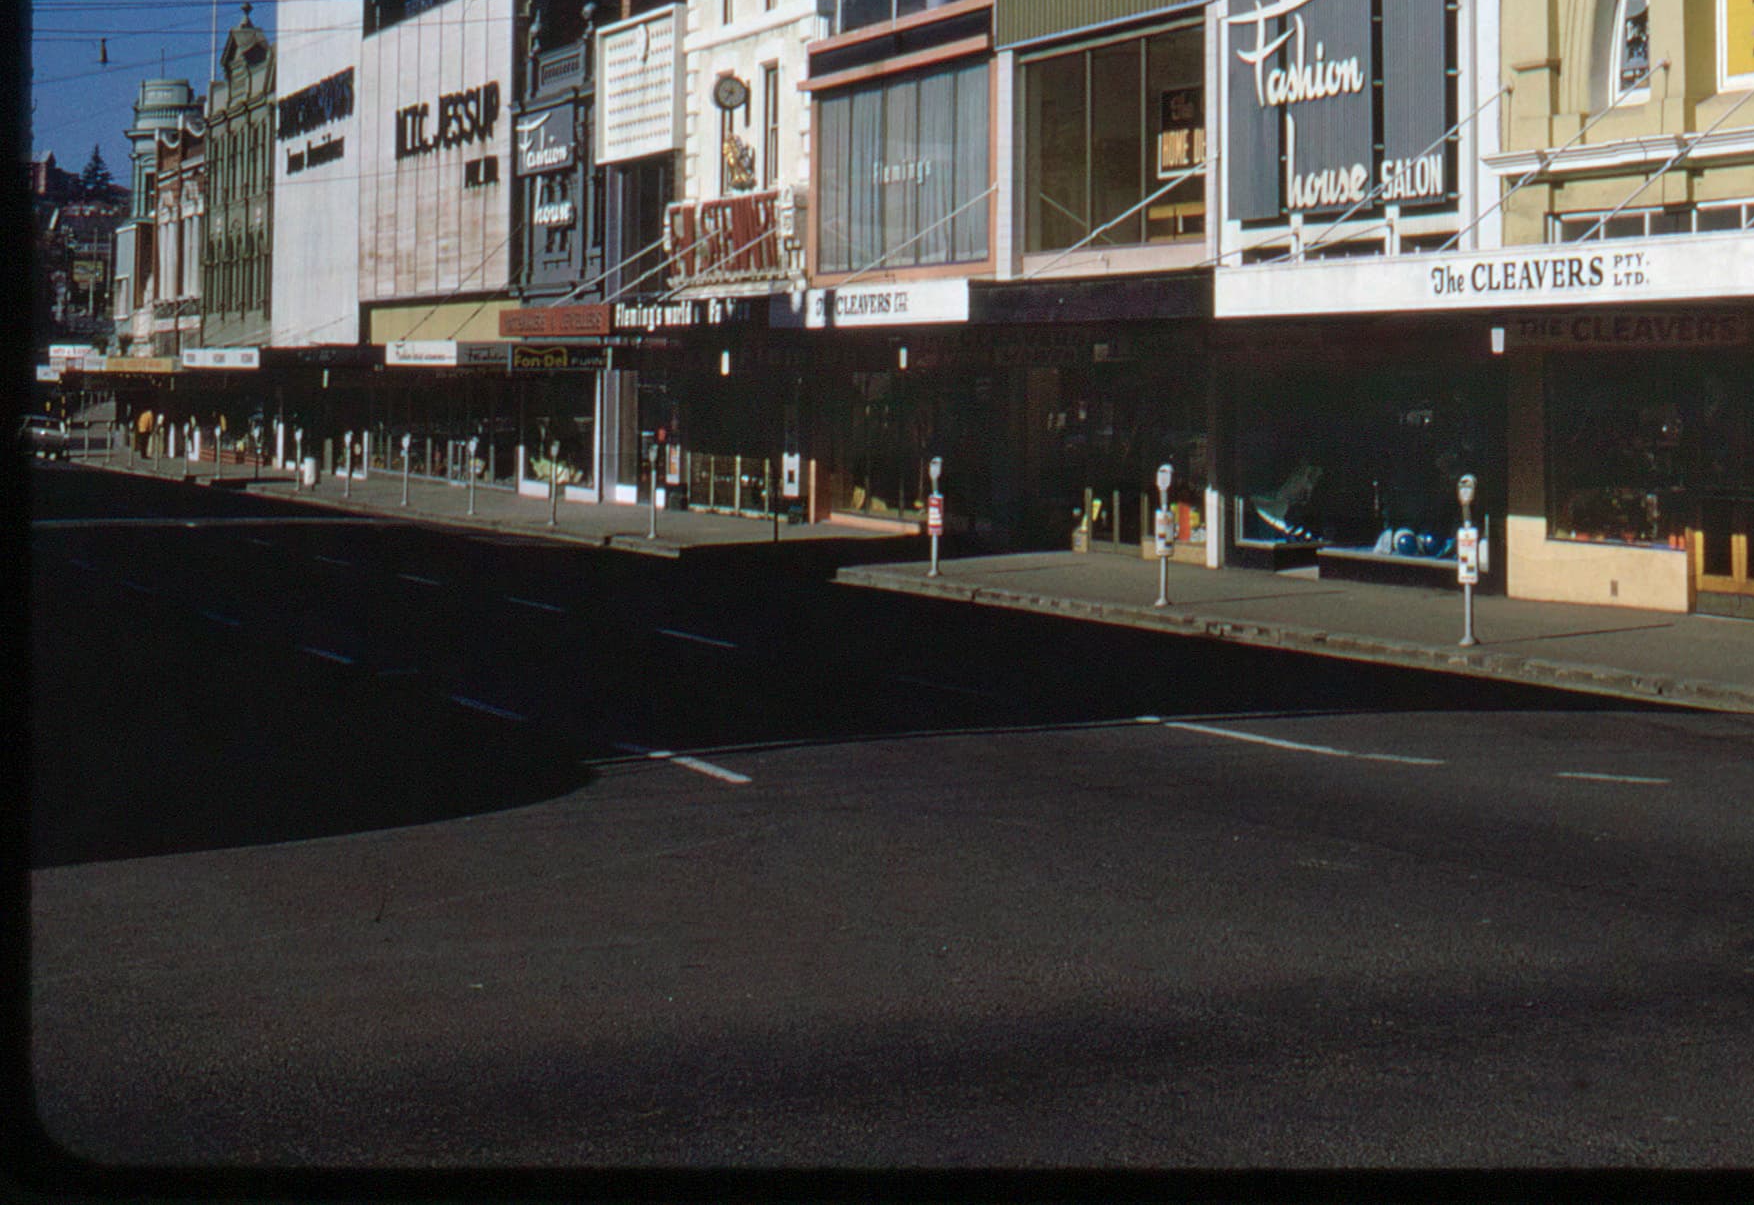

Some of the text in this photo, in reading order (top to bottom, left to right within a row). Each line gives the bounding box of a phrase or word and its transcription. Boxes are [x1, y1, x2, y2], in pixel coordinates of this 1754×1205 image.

[433, 80, 499, 150] JESSUP
[1286, 114, 1443, 210] house SALON
[1431, 265, 1466, 295] The
[1470, 256, 1606, 293] CLEAVERS
[837, 292, 892, 315] CLEAVERS
